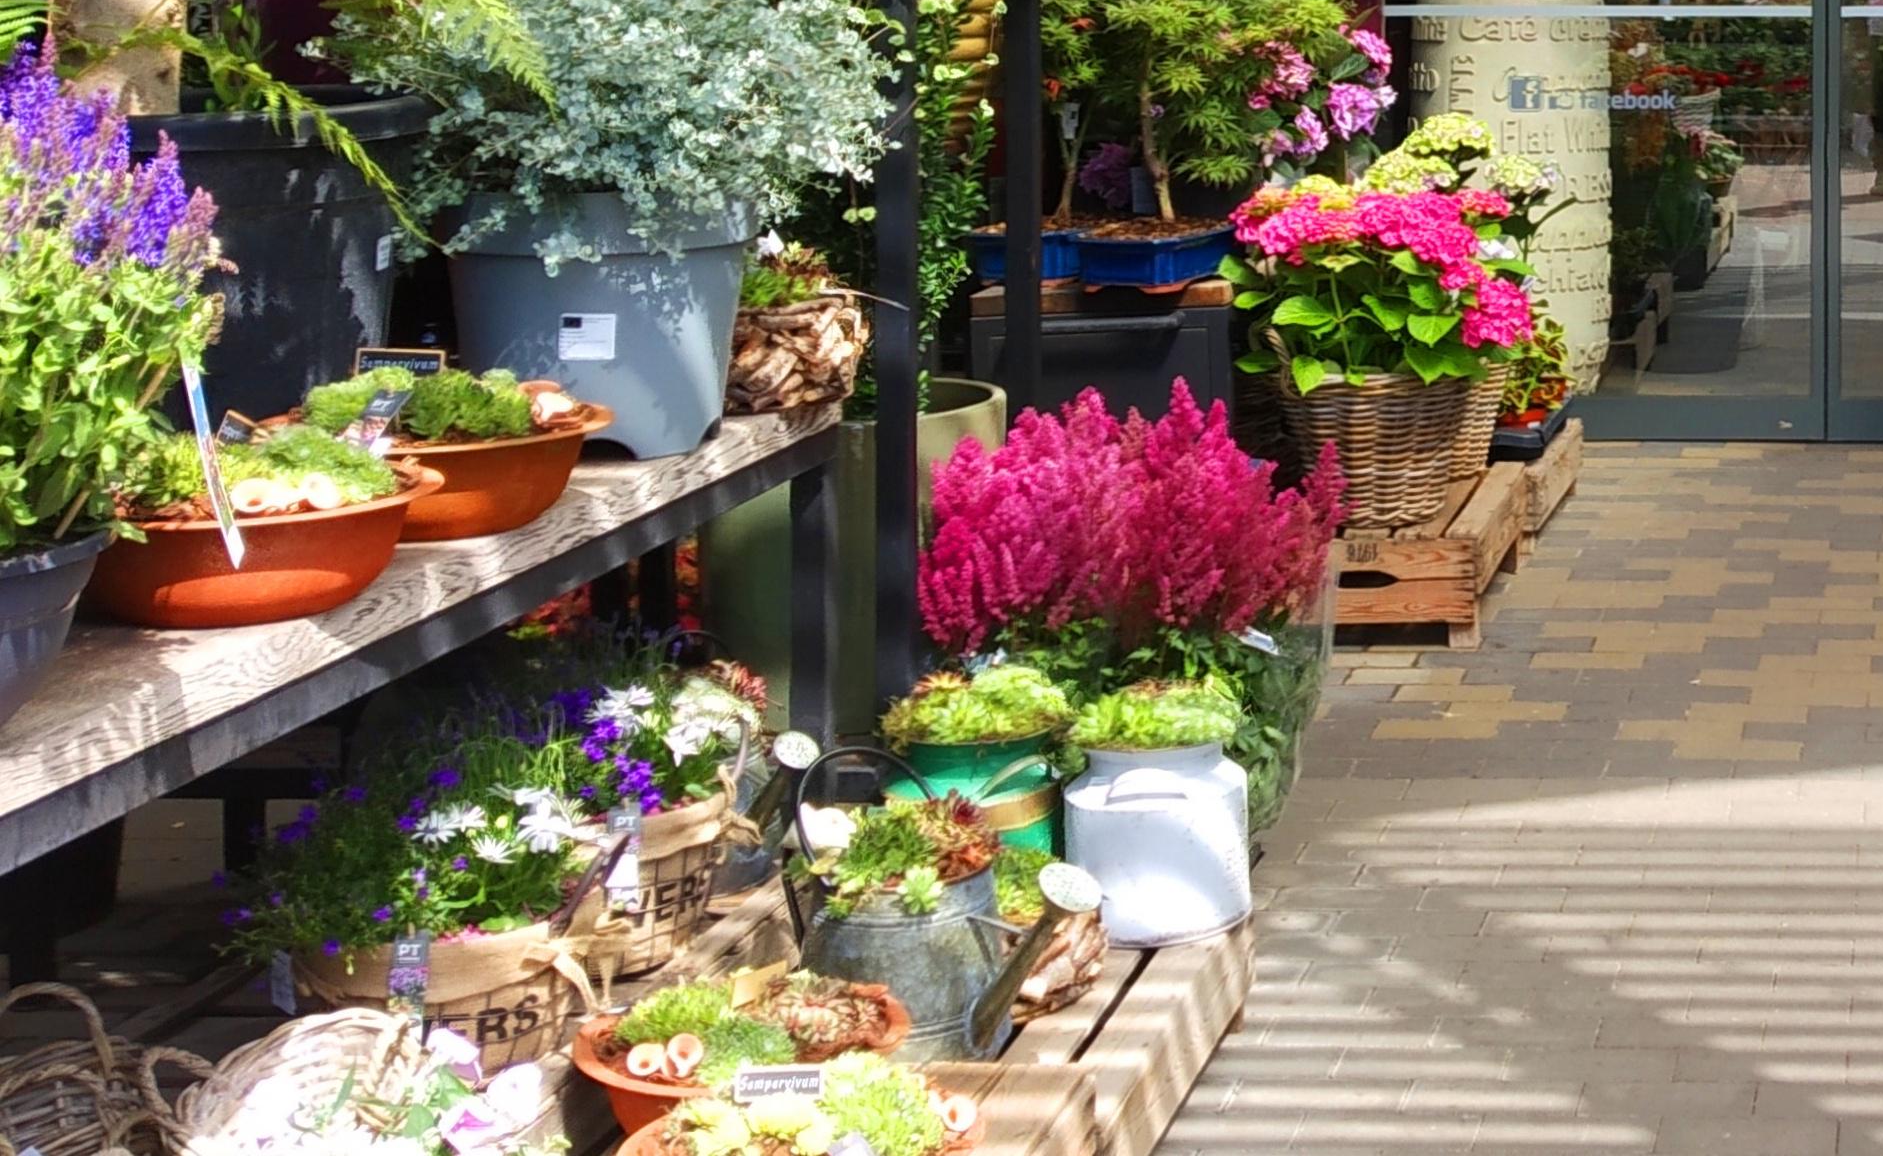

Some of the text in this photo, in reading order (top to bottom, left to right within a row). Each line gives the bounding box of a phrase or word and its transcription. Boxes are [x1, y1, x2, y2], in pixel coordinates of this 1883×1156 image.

[1580, 87, 1676, 111] facebook
[614, 815, 637, 827] PT
[398, 943, 422, 956] PT
